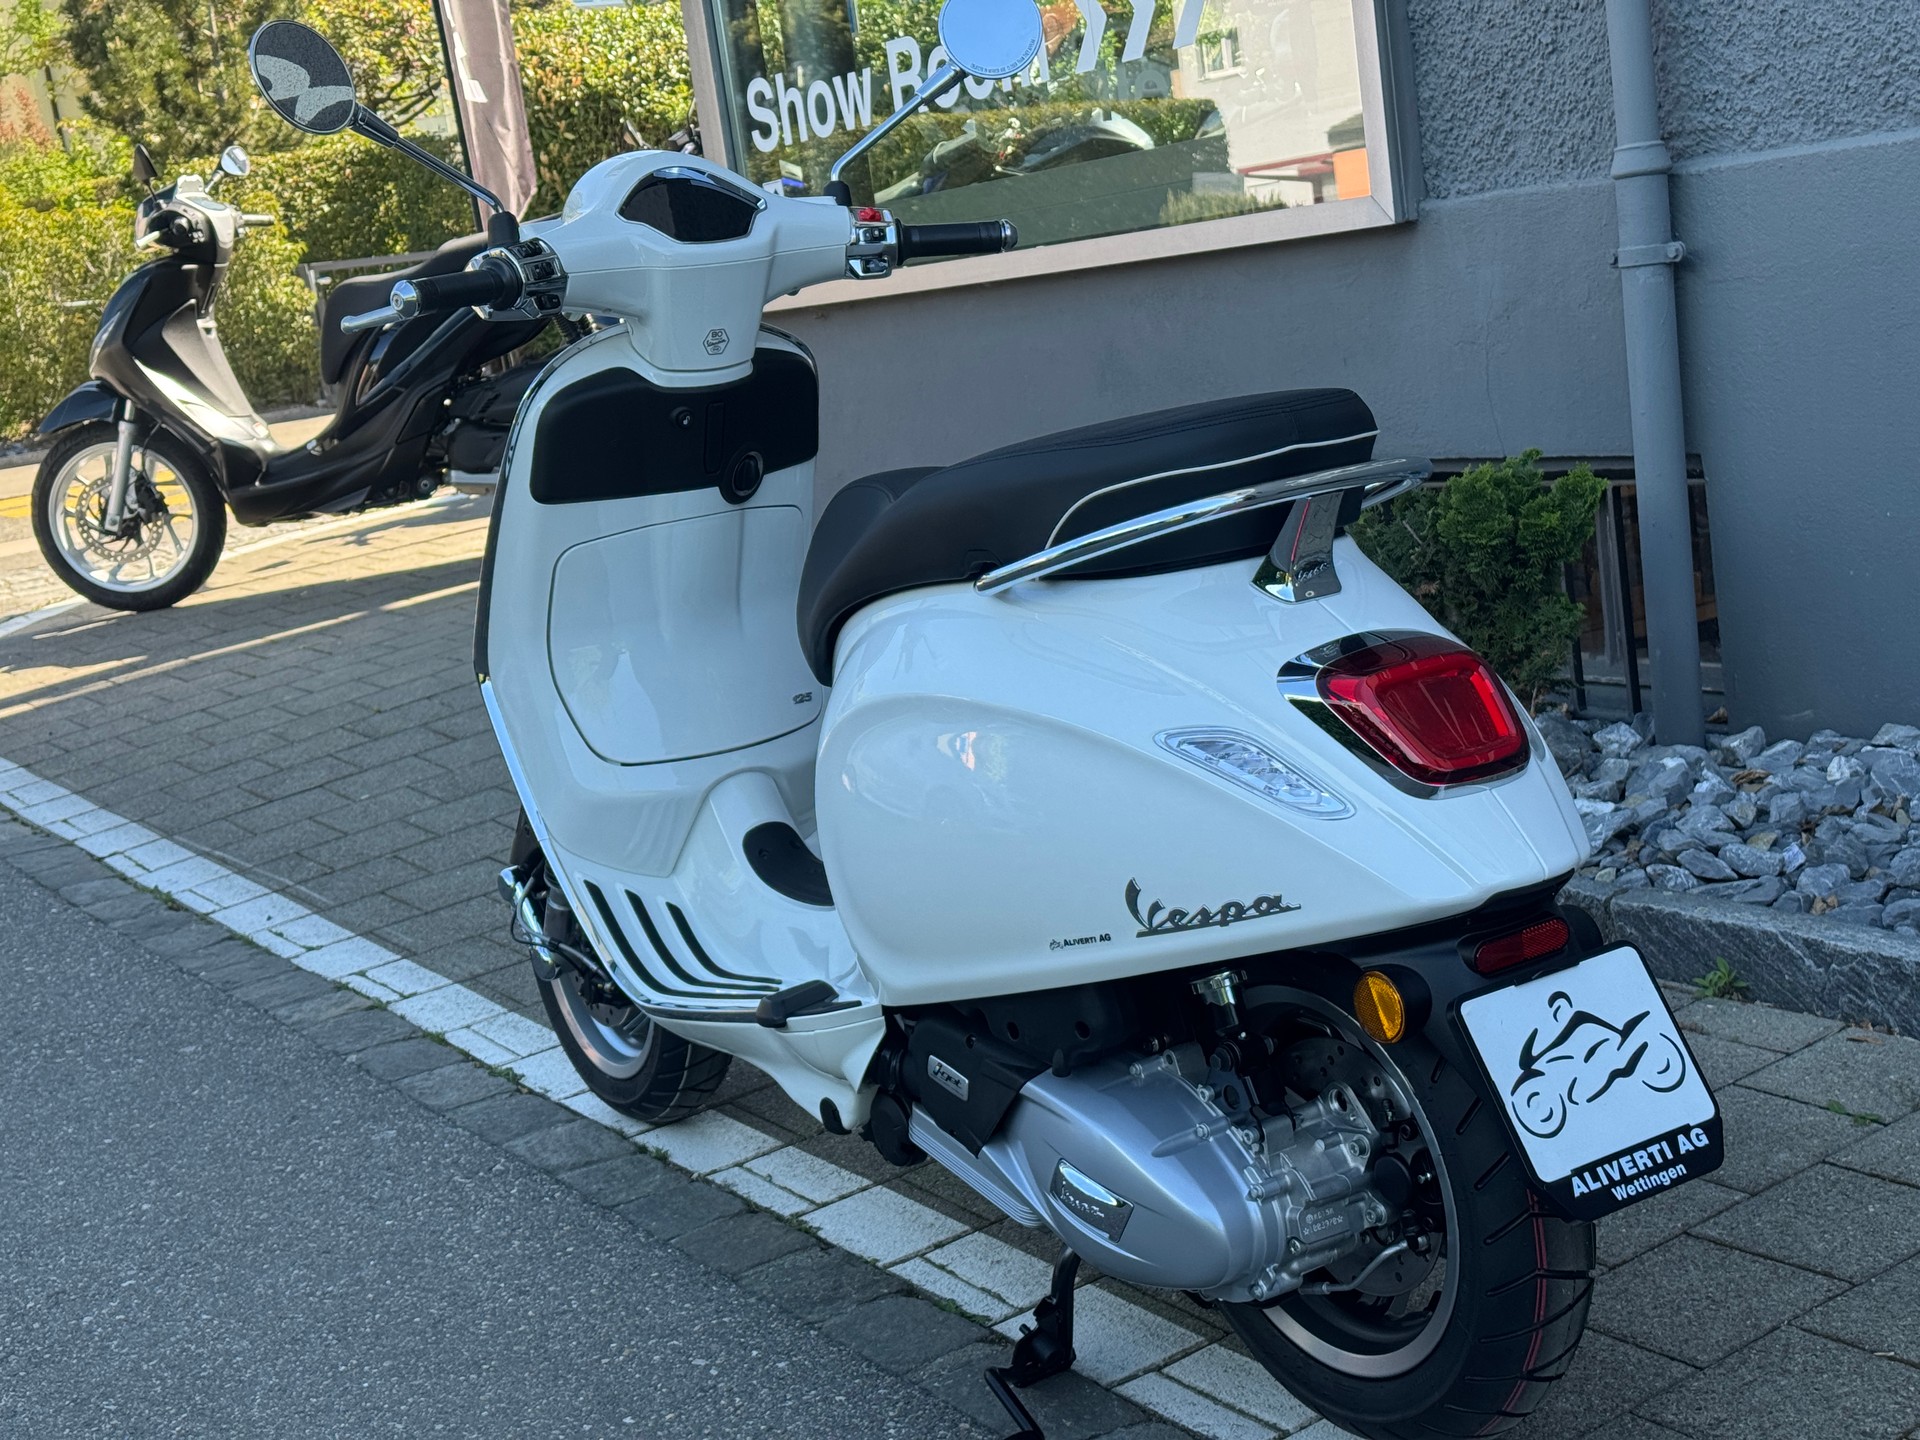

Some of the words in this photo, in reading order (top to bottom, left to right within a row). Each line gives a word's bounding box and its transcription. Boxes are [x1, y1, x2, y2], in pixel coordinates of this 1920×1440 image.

[746, 67, 872, 153] Show
[886, 34, 1049, 112] Ro
[1124, 876, 1302, 938] Vespa
[1099, 933, 1112, 944] AG
[1571, 1140, 1674, 1198] ALIVERTI
[1676, 1127, 1710, 1155] AG
[1611, 1163, 1688, 1201] Wettingen
